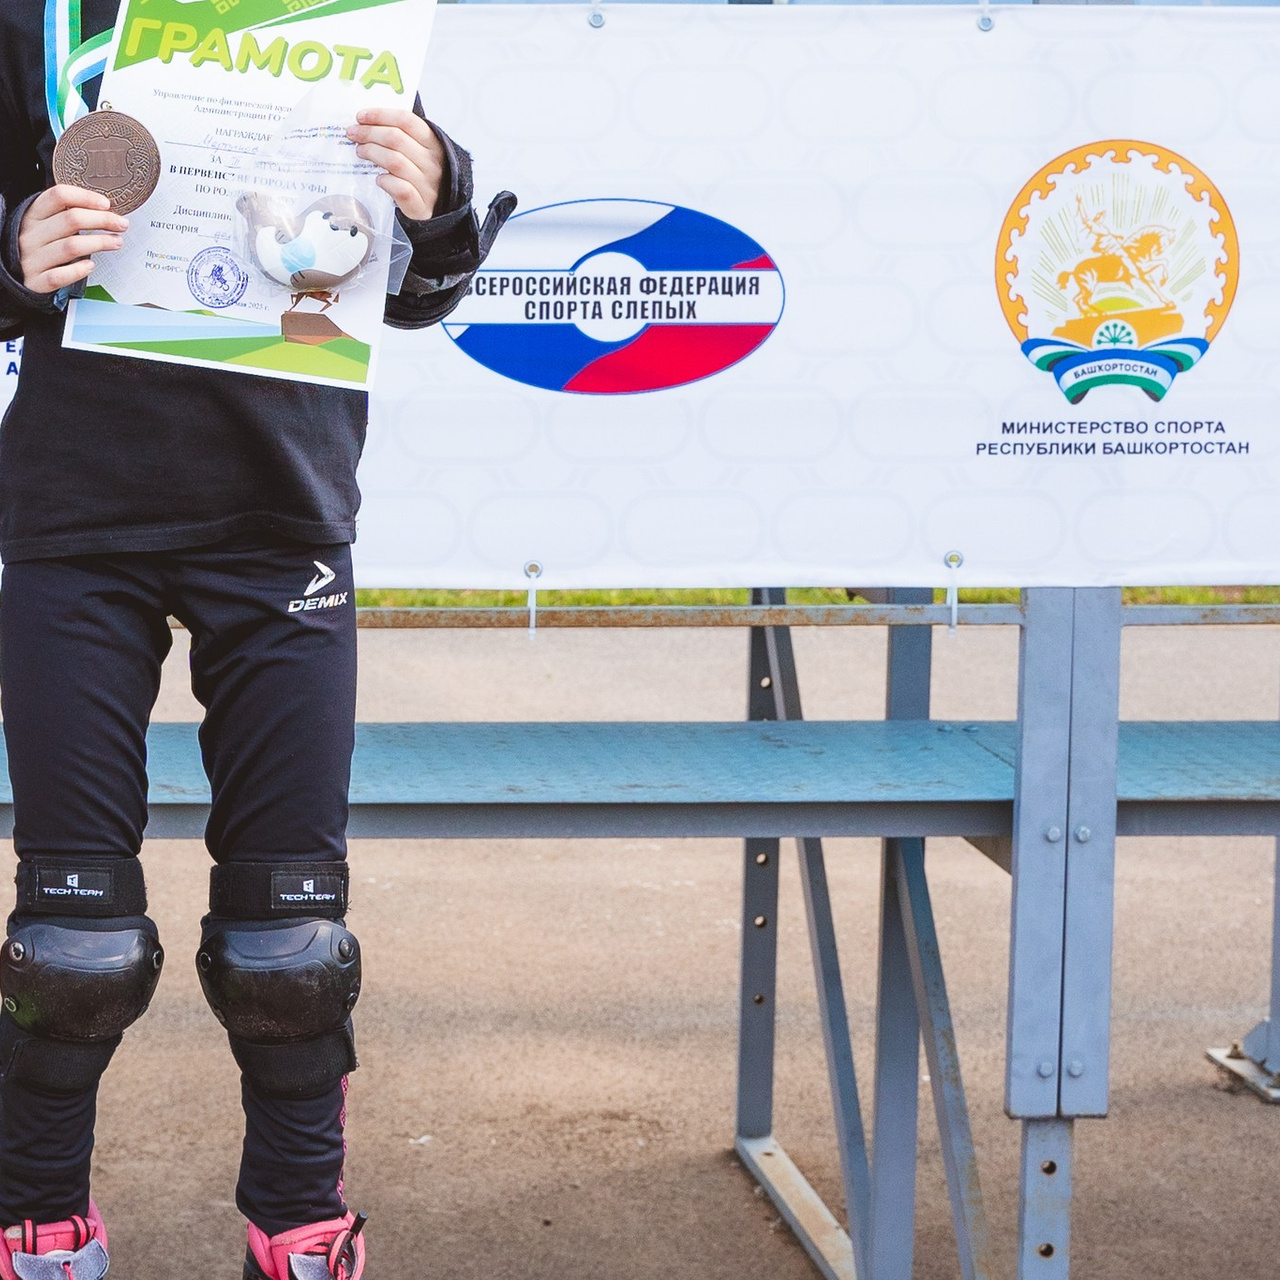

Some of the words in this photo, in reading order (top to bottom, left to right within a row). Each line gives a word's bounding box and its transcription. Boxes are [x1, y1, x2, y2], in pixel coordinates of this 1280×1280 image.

[124, 17, 405, 95] ГРАМОТА
[152, 89, 205, 102] Управление
[219, 96, 273, 112] физической
[194, 105, 266, 120] Администрации
[150, 220, 199, 234] категория
[639, 275, 760, 298] ФЕДЕРАЦИЯ
[524, 300, 603, 321] СПОРТА
[611, 299, 697, 320] СЛЕПЫХ
[1001, 421, 1148, 435] МИНИСТЕРСТВО
[1154, 421, 1226, 435] СПОРТА
[976, 442, 1096, 456] РЕСПУБЛИКИ
[1102, 441, 1250, 455] БАШКОРТОСТАН
[288, 591, 348, 613] DEMIX
[42, 887, 71, 895] TECH
[72, 888, 104, 897] TEAM
[280, 893, 308, 901] TECH
[309, 893, 336, 901] TEAM
